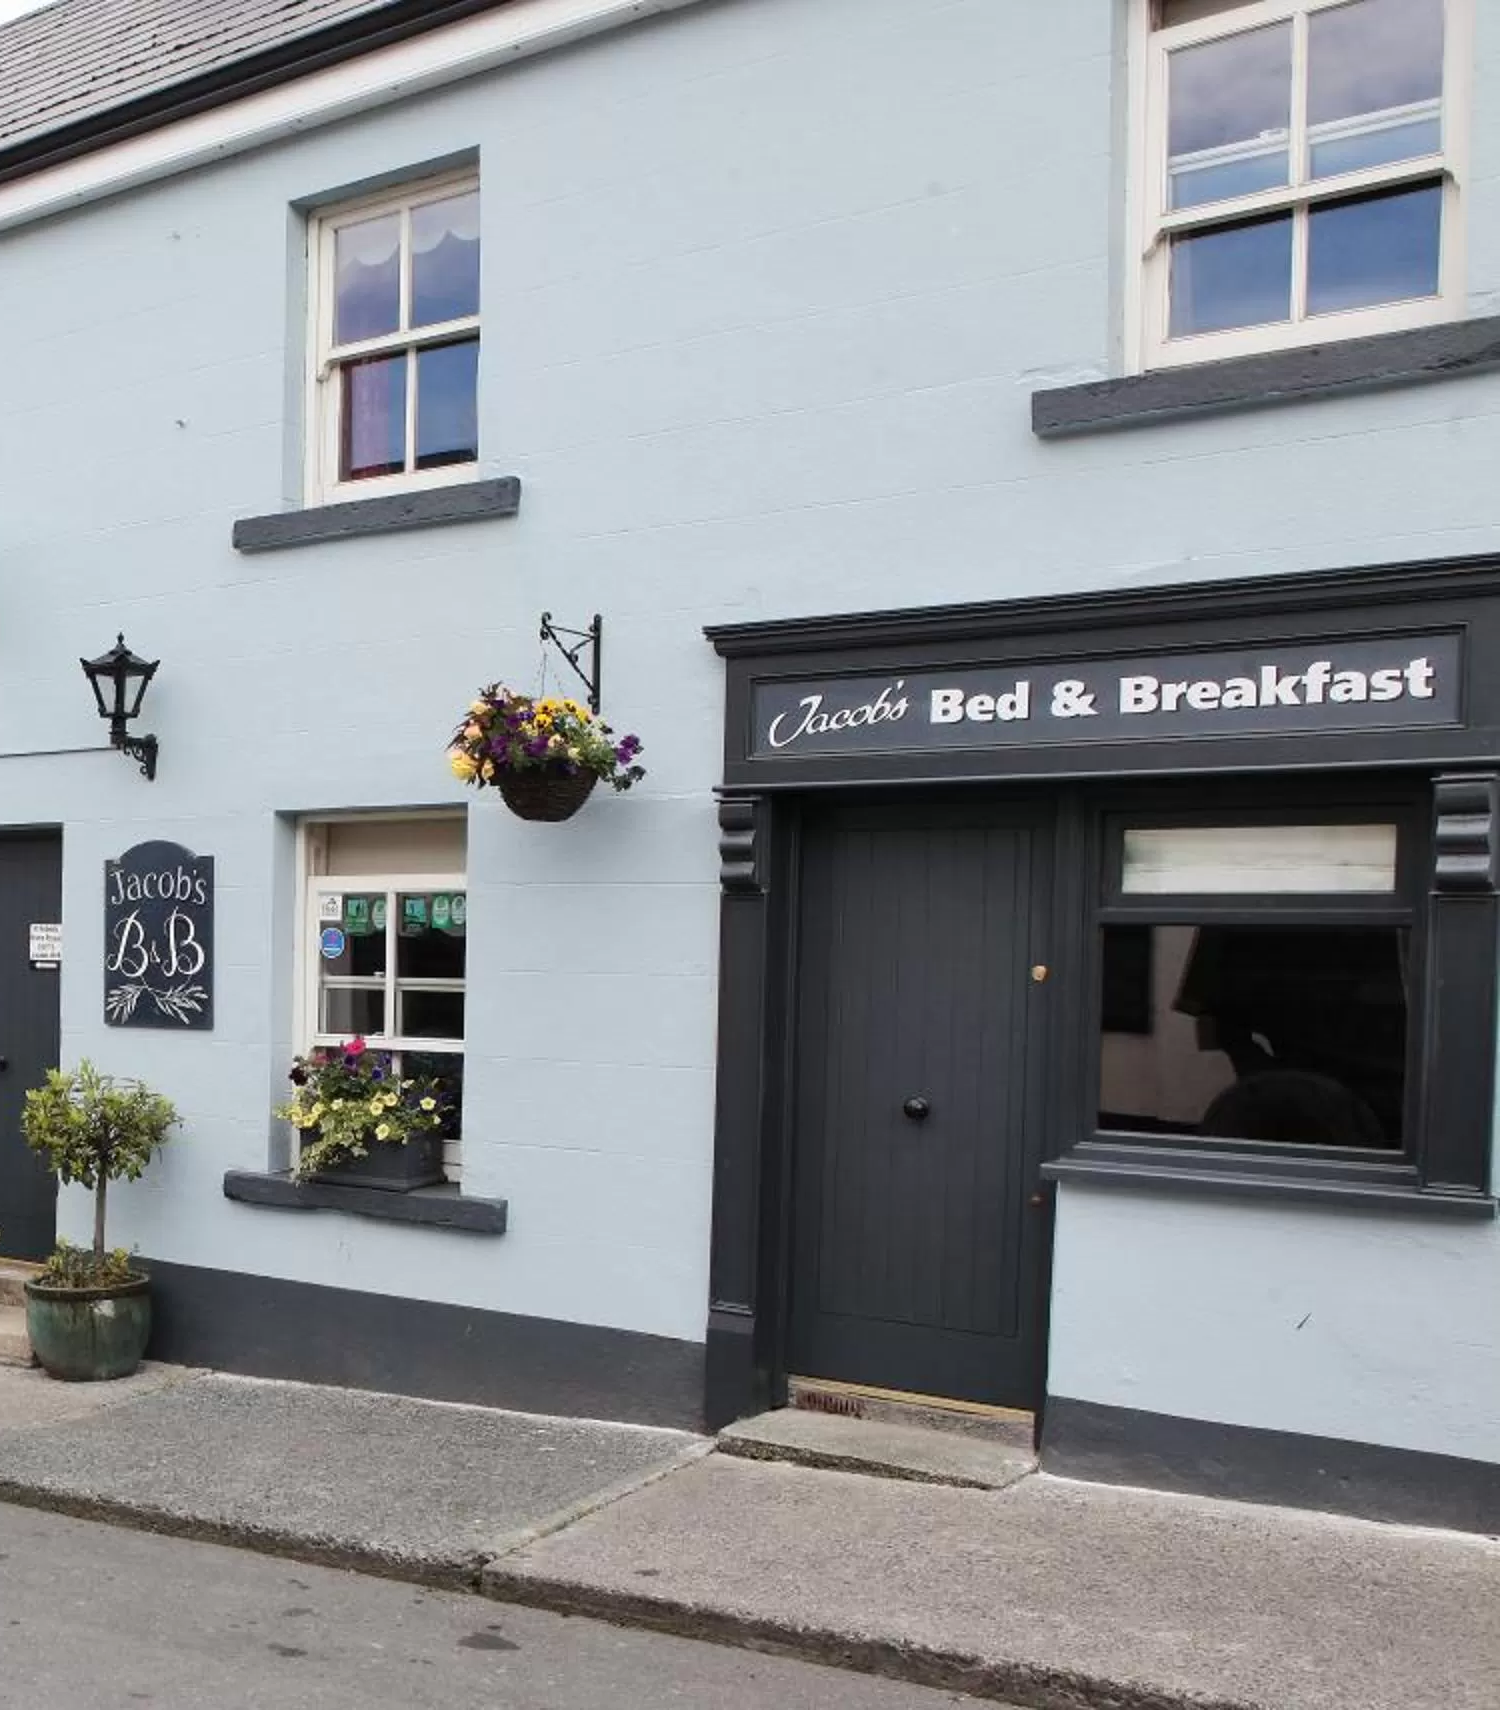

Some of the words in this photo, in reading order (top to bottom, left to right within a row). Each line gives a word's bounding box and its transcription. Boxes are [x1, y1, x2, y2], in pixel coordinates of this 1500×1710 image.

[768, 679, 909, 748] Jacob's
[929, 681, 1030, 724] Bed
[1050, 679, 1099, 717] &
[1119, 657, 1434, 715] Breakfast
[109, 866, 207, 905] Jacob's
